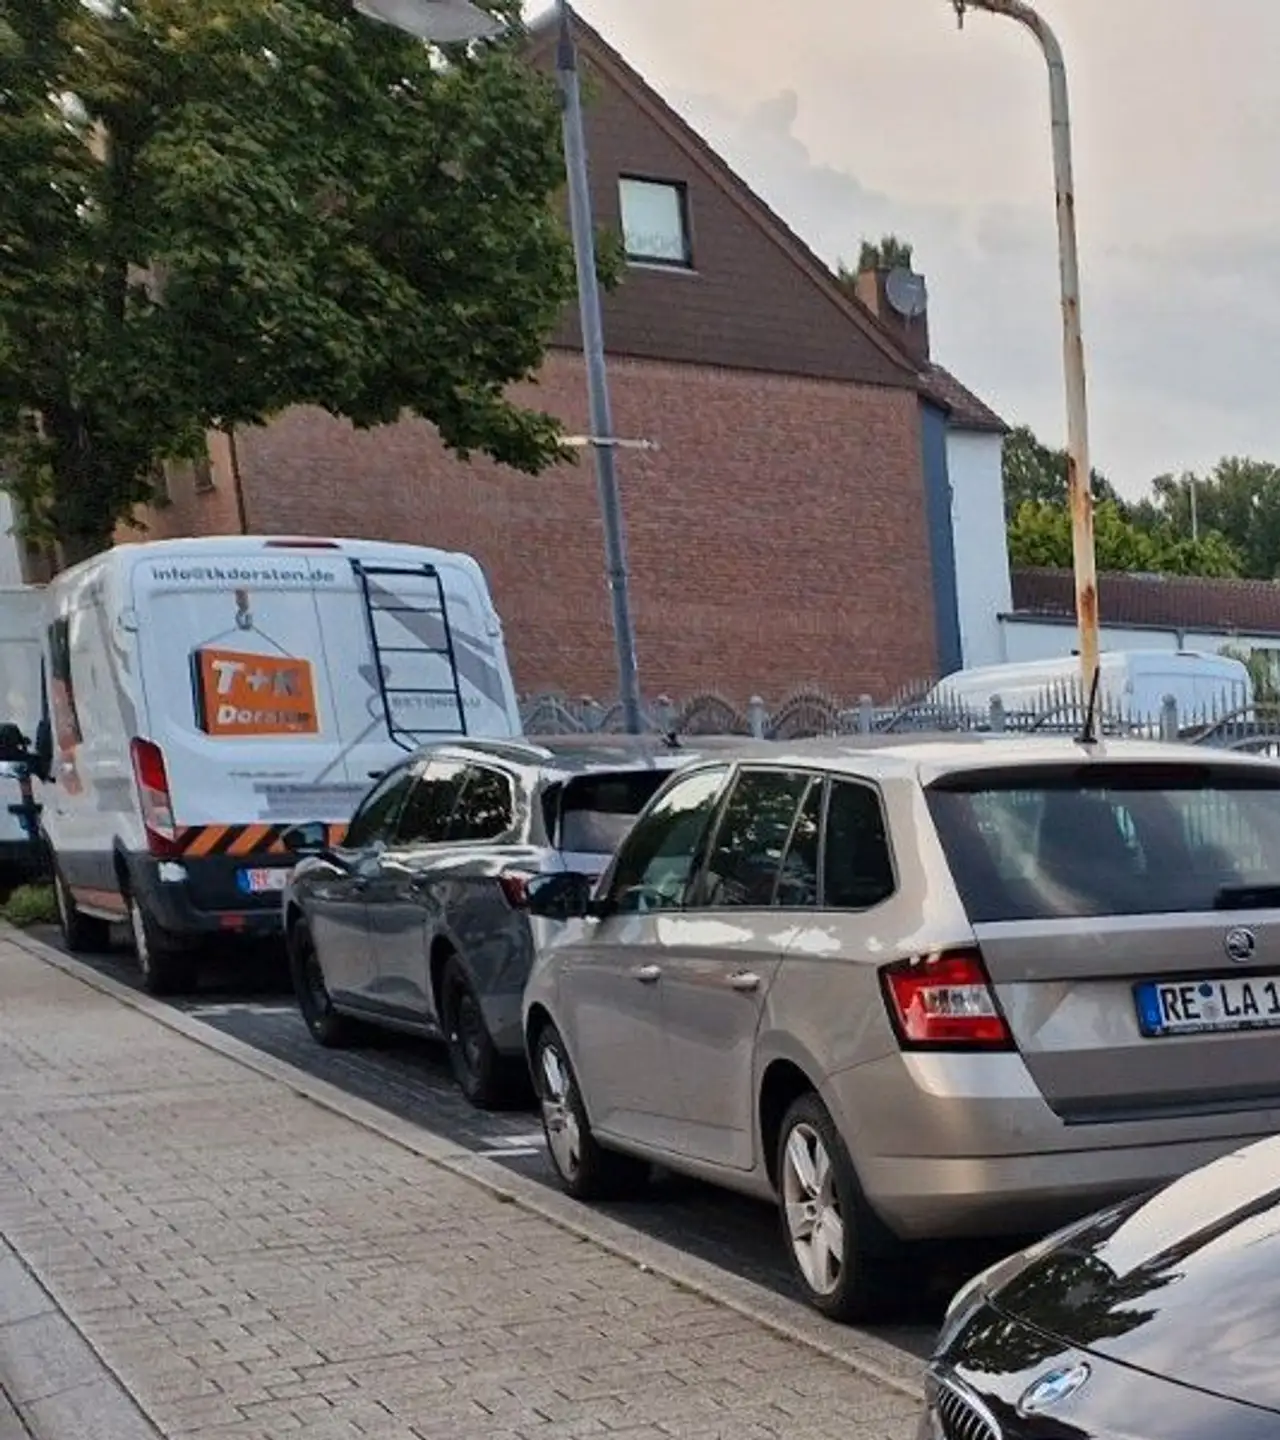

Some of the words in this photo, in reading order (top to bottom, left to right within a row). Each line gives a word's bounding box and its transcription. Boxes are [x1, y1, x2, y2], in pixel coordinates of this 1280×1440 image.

[152, 567, 335, 583] info@tkdorsten.de
[211, 659, 300, 697] T+K
[1160, 986, 1201, 1021] RE
[1219, 982, 1260, 1017] LA
